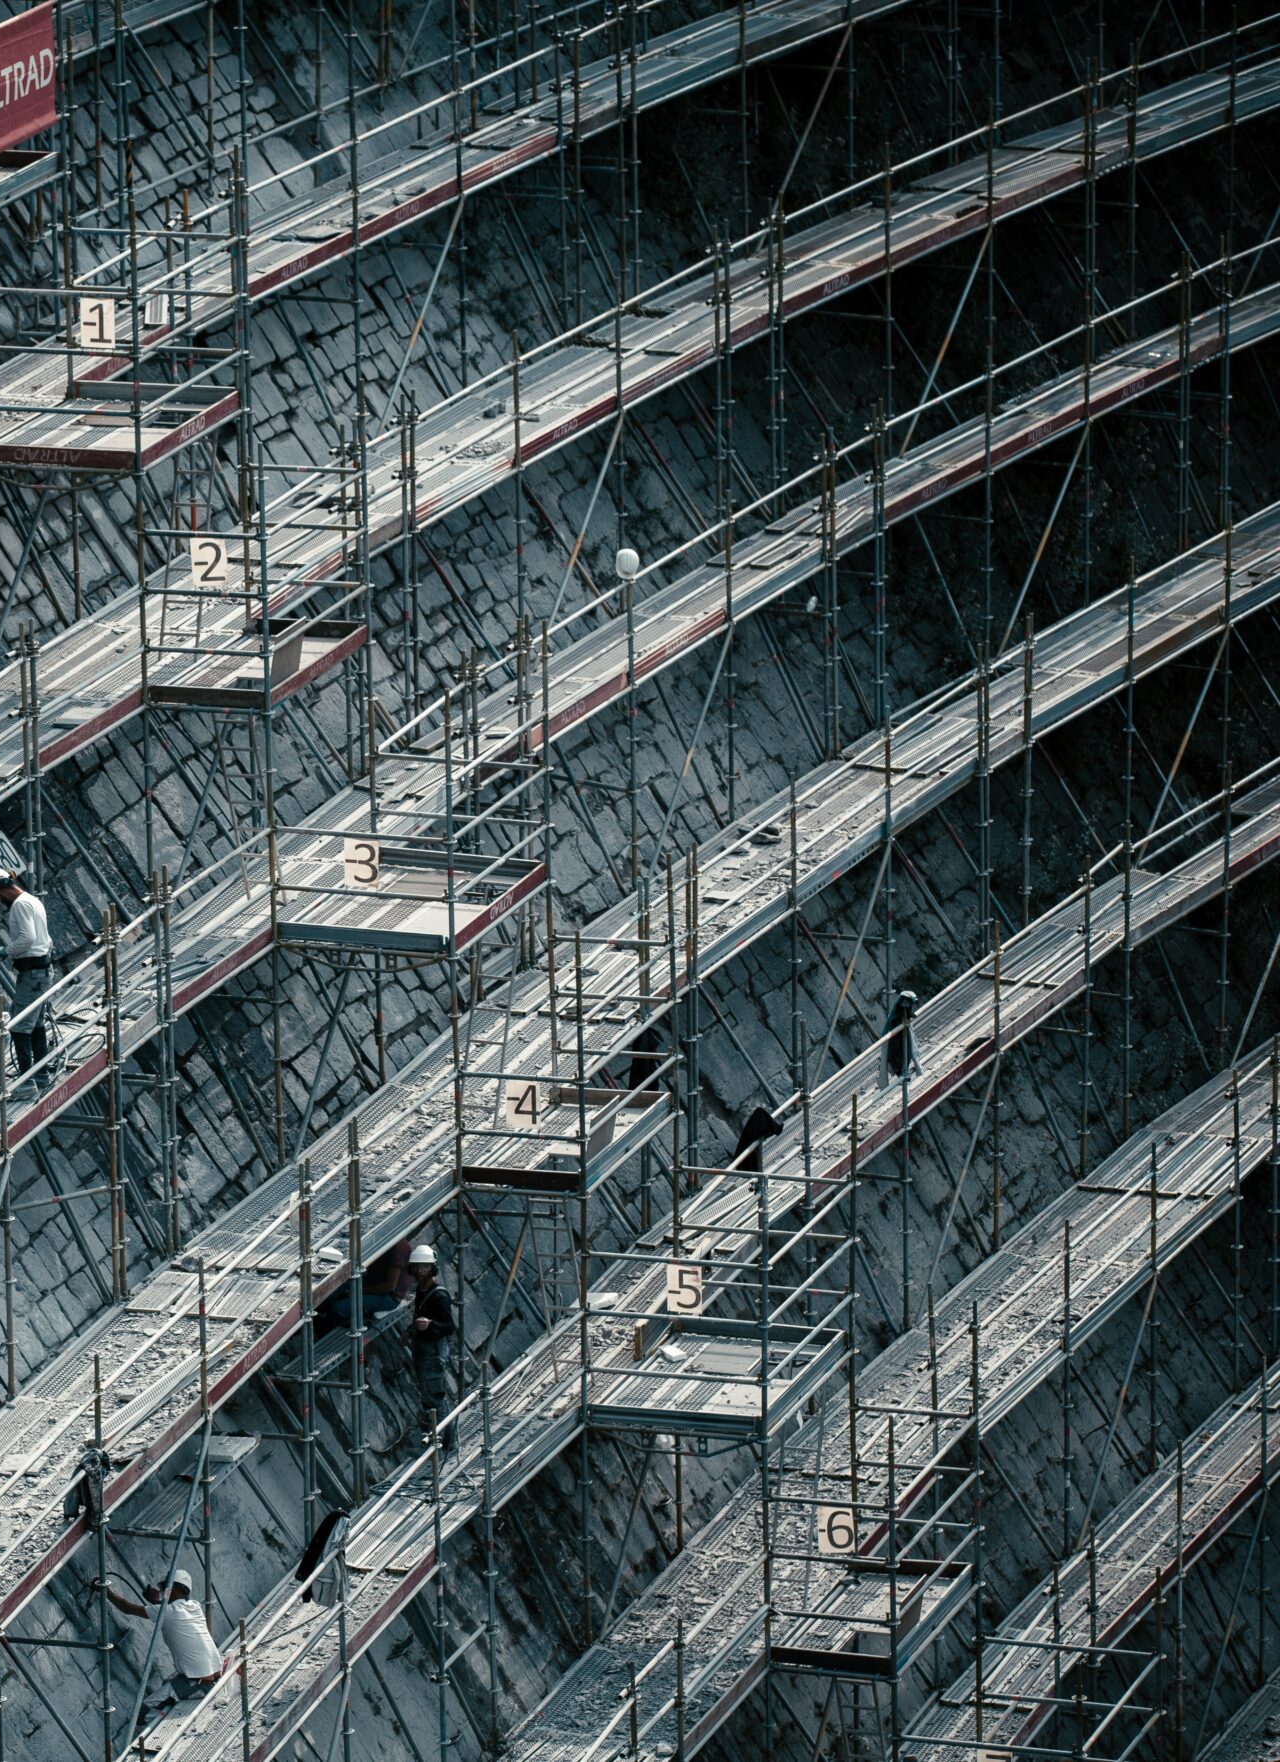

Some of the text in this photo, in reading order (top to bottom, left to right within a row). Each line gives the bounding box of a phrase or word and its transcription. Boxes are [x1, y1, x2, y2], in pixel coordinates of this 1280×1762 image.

[395, 201, 420, 222] ALTRAD
[281, 258, 308, 279] ALTRAD
[823, 275, 850, 295] ALTRAD
[83, 303, 112, 344] -1
[1121, 378, 1145, 399] ALTRAD
[180, 416, 206, 442] ALTRAD
[1028, 422, 1052, 442] ALTRAD
[14, 447, 82, 464] ALTRAD
[194, 542, 225, 582] -2
[560, 700, 586, 726] ALTRAD
[345, 843, 378, 883] -3
[490, 892, 515, 920] ALTRAD
[939, 1067, 964, 1093] ALTRAD
[42, 1087, 68, 1118] ALTRAD
[507, 1085, 541, 1125] -4
[669, 1269, 701, 1309] -5
[243, 1340, 267, 1372] ALTRAD
[819, 1511, 854, 1549] -6
[40, 1539, 67, 1577] ALTRAD
